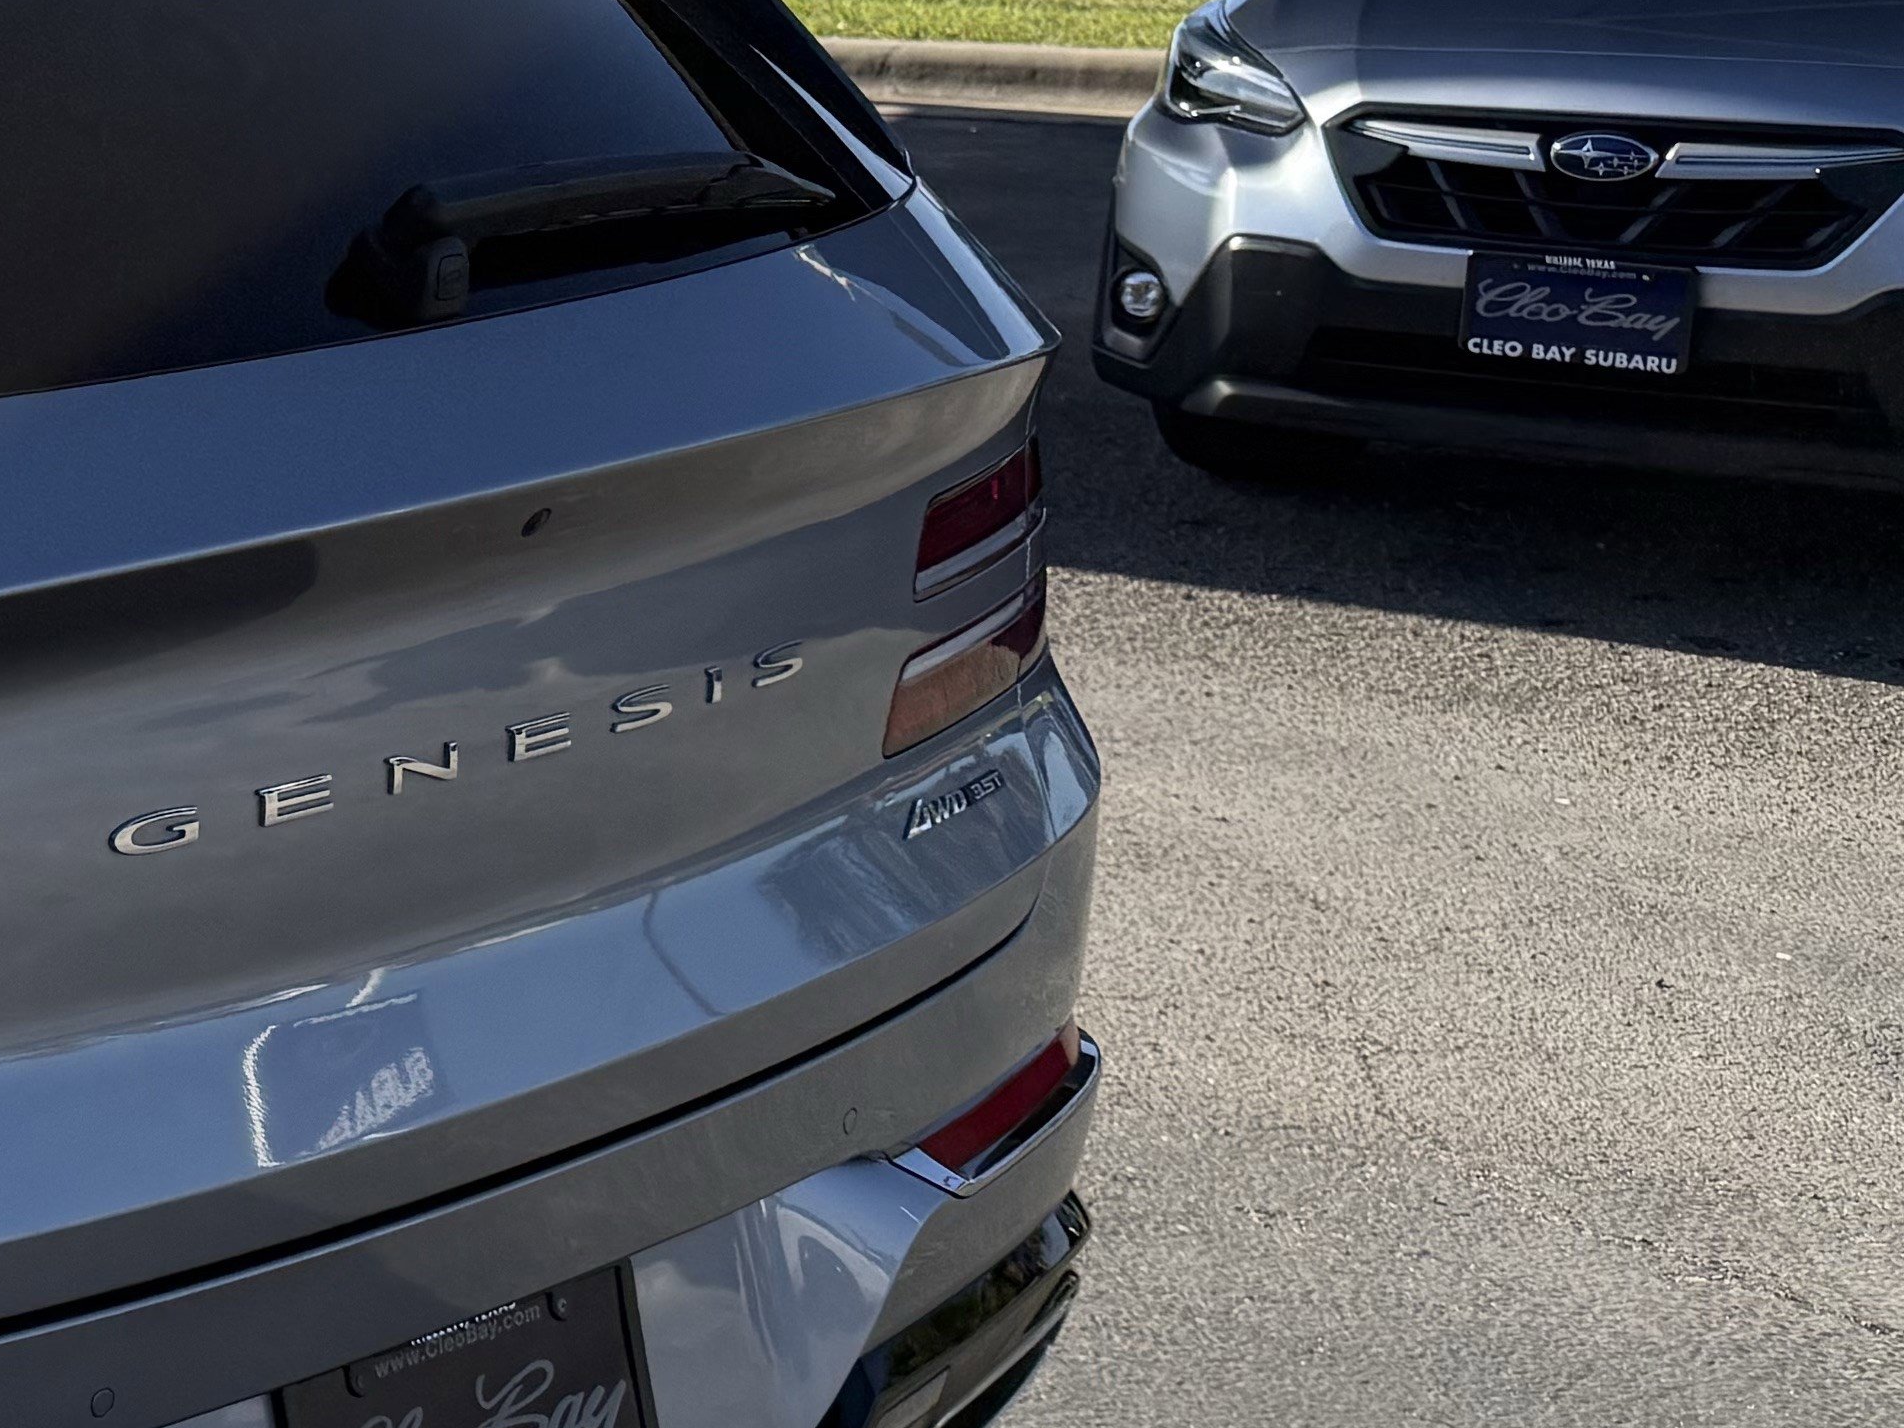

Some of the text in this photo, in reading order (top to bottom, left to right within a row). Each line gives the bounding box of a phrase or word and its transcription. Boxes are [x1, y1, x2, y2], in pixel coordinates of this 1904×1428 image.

[1476, 278, 1680, 341] Cleo Bay
[1467, 337, 1677, 374] CLEO BAY SUBARU
[109, 639, 803, 856] GENESIS
[374, 1304, 541, 1378] www.CleoBay.com
